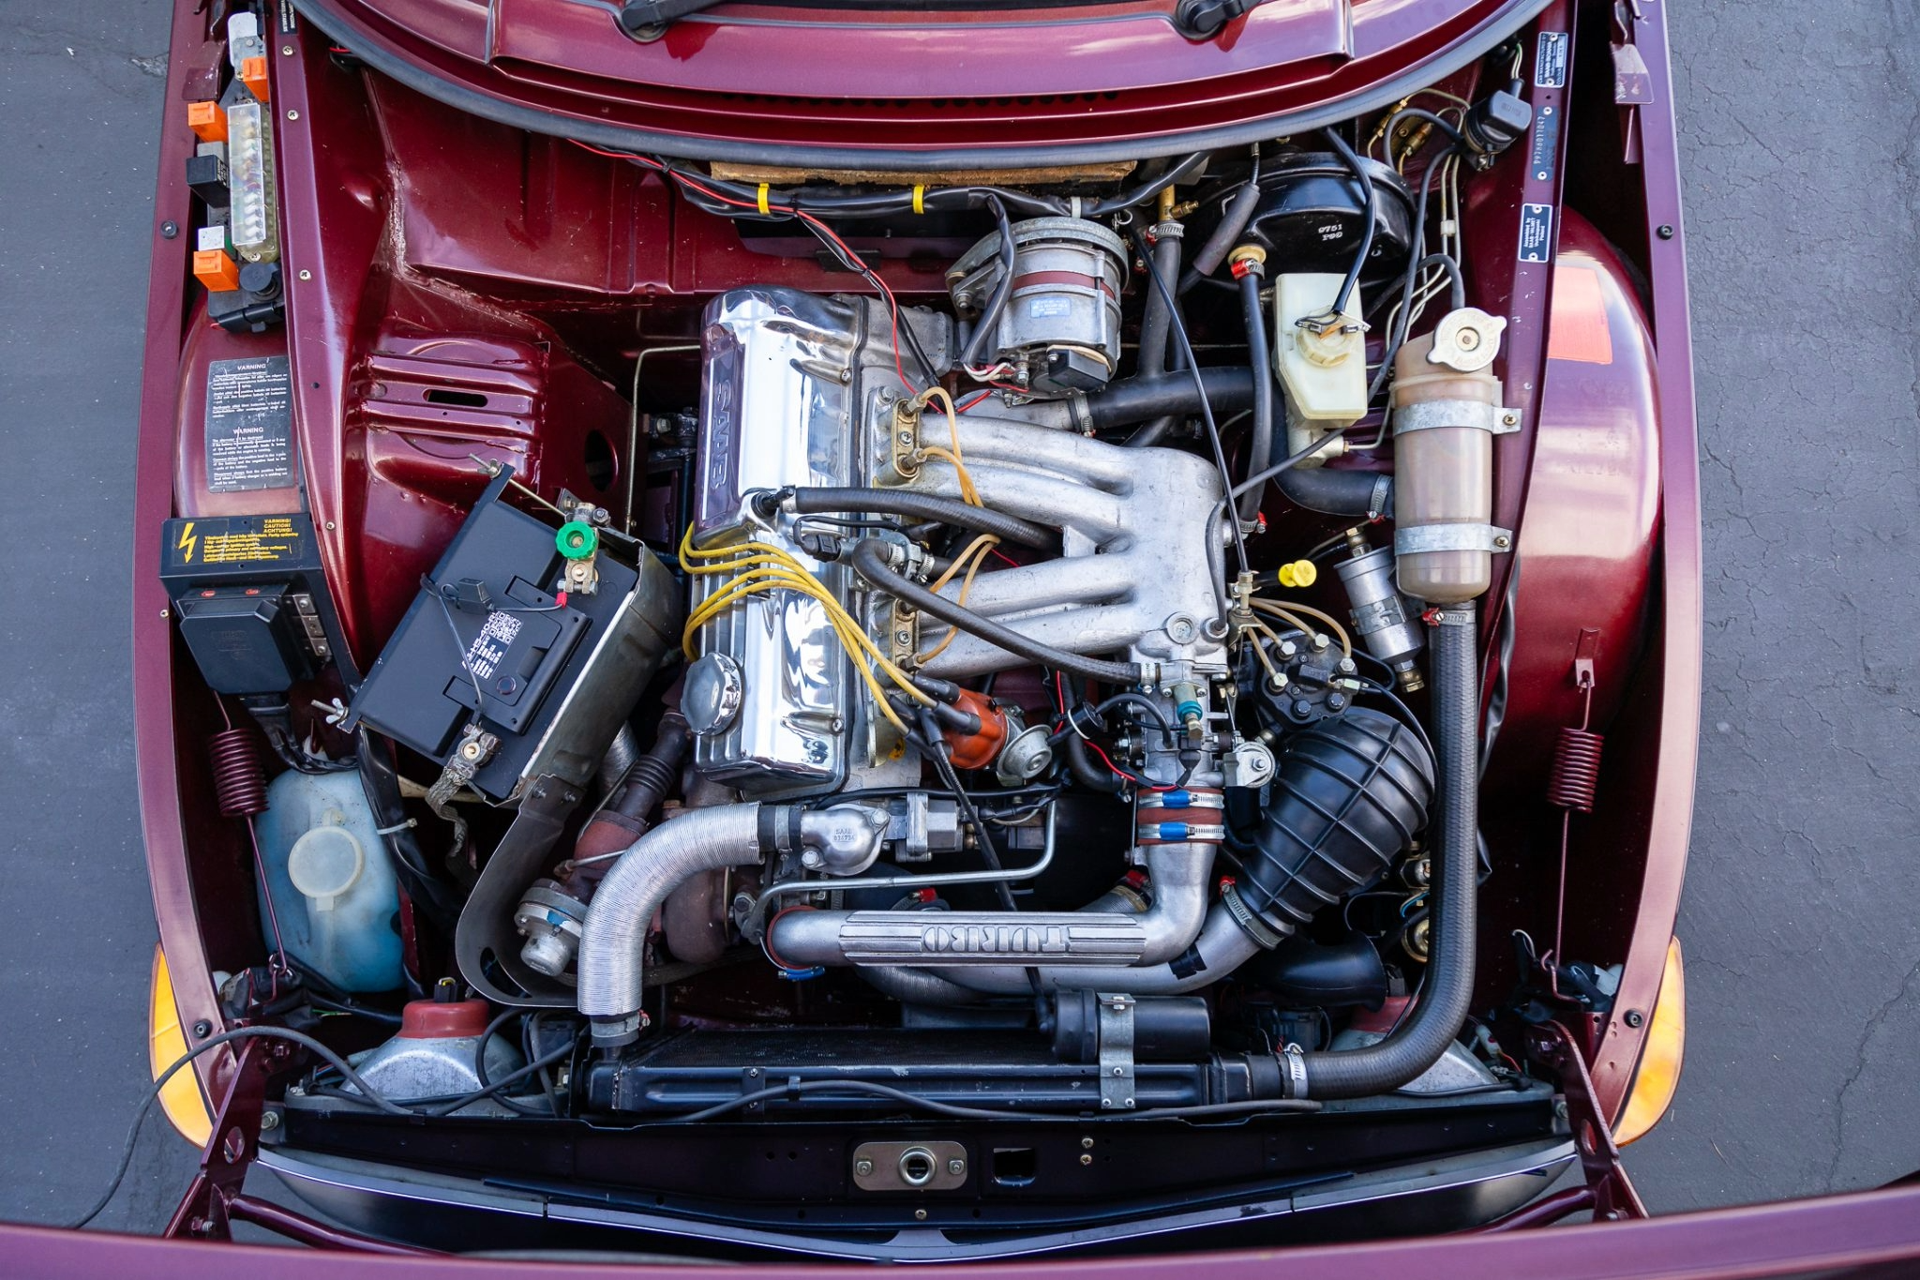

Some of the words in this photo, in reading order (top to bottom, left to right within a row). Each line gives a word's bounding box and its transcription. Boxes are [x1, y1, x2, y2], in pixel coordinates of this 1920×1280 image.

[237, 363, 267, 371] VARNING
[232, 426, 264, 435] WARNING
[711, 379, 732, 490] SAAB
[923, 925, 1067, 953] TURBO
